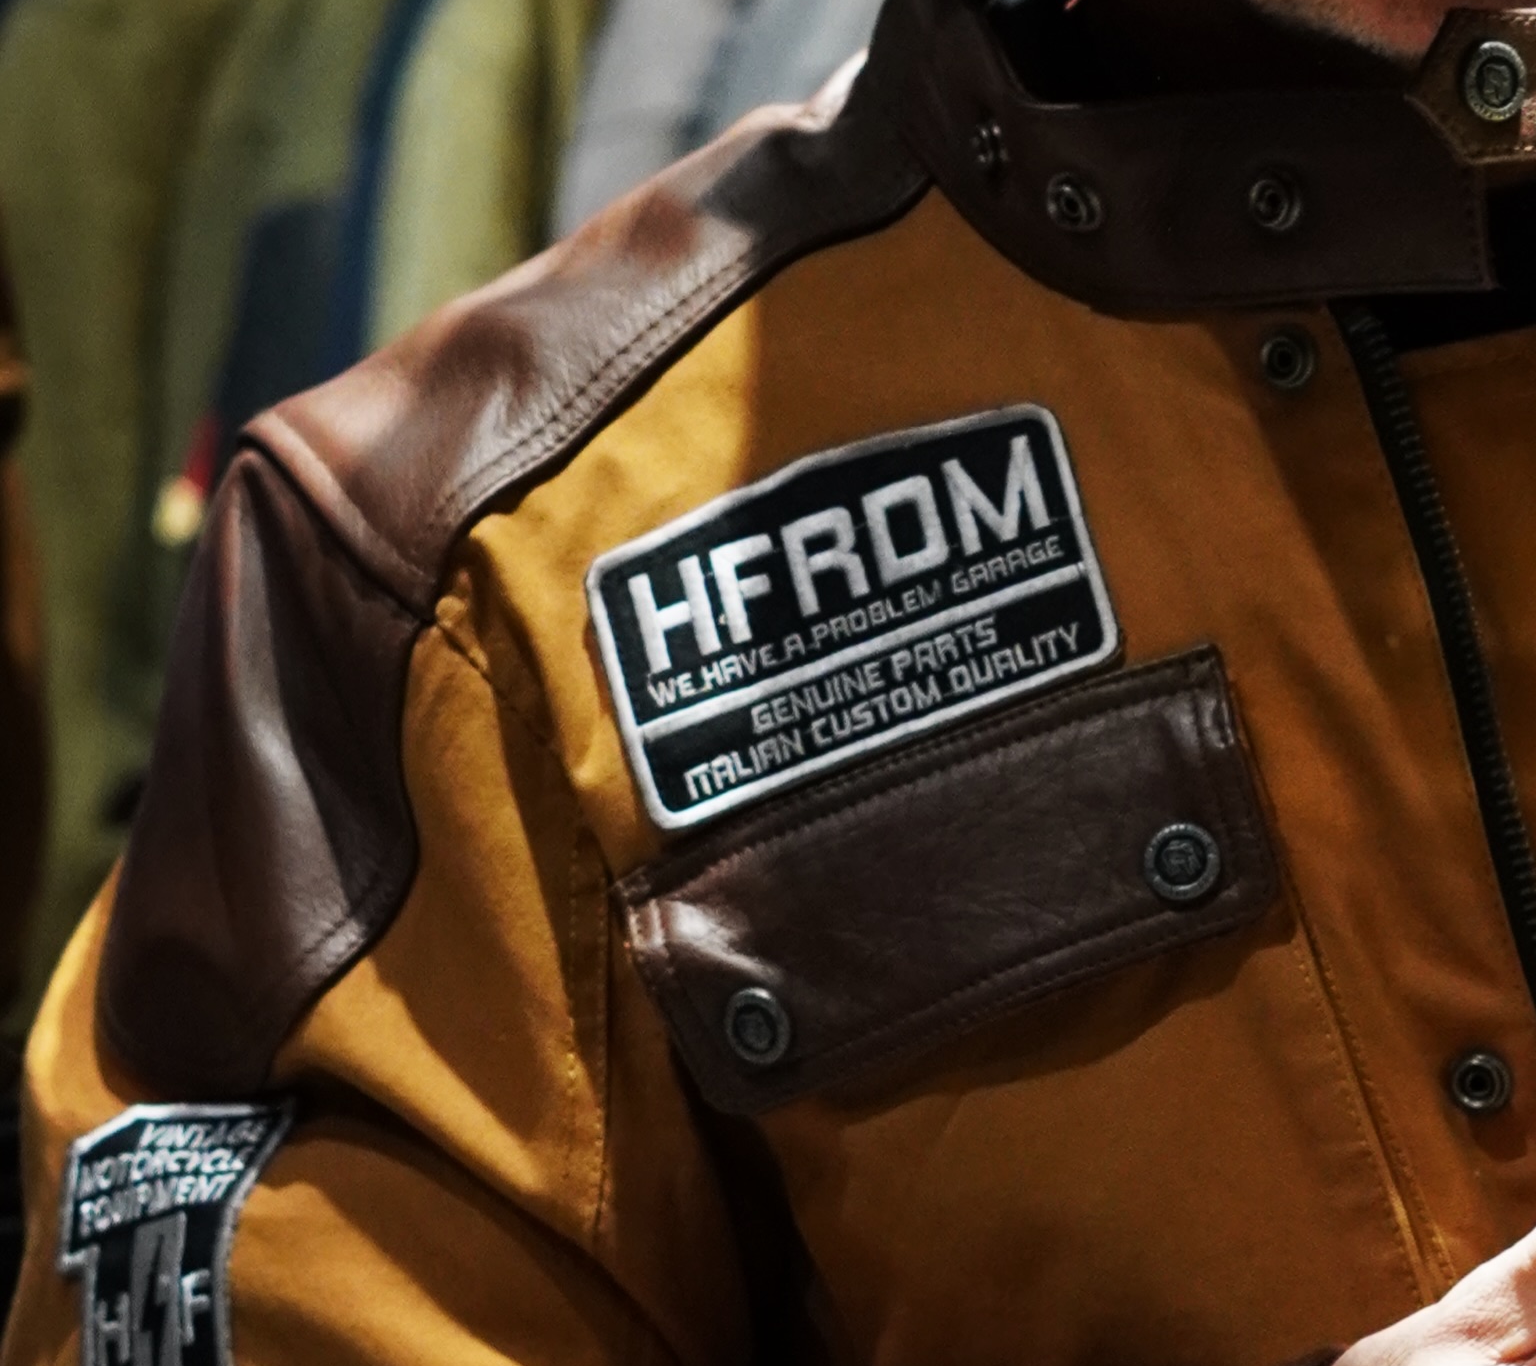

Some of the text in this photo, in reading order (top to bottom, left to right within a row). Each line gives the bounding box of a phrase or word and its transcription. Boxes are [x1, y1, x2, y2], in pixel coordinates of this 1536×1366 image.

[627, 435, 1052, 675] HFRDM
[648, 536, 1064, 708] WE HAVE A PROBLEM GARAGE
[683, 623, 1081, 802] ITALIAN CUSTOM QUALITY
[750, 615, 998, 735] GENUINE PARTS
